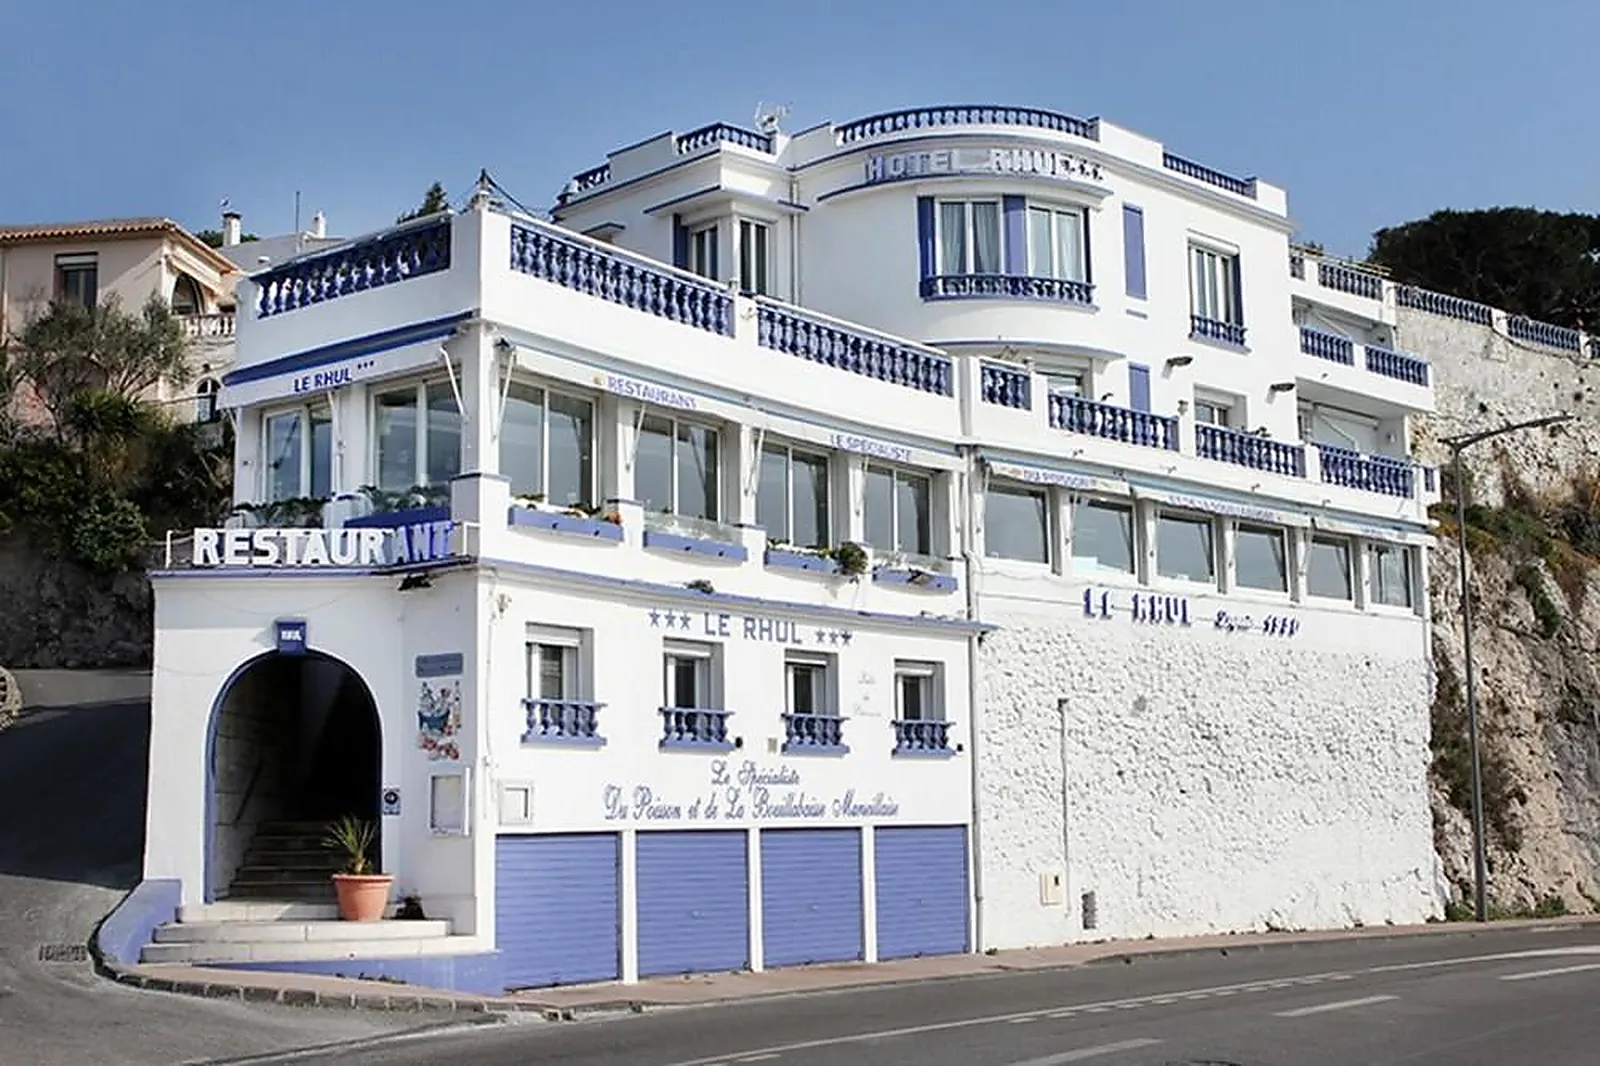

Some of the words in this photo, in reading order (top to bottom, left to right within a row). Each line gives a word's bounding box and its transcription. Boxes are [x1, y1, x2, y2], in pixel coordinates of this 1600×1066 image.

[866, 148, 959, 182] HOTEL
[293, 375, 311, 393] LE
[314, 368, 353, 390] RHUL
[606, 375, 698, 410] RESTAURANT
[193, 521, 454, 566] RESTAURANT
[1083, 588, 1114, 620] LE
[1132, 593, 1191, 629] RHUL
[703, 612, 731, 637] LE
[743, 617, 803, 645] RHUL
[711, 759, 730, 785] Le
[604, 784, 628, 820] Du
